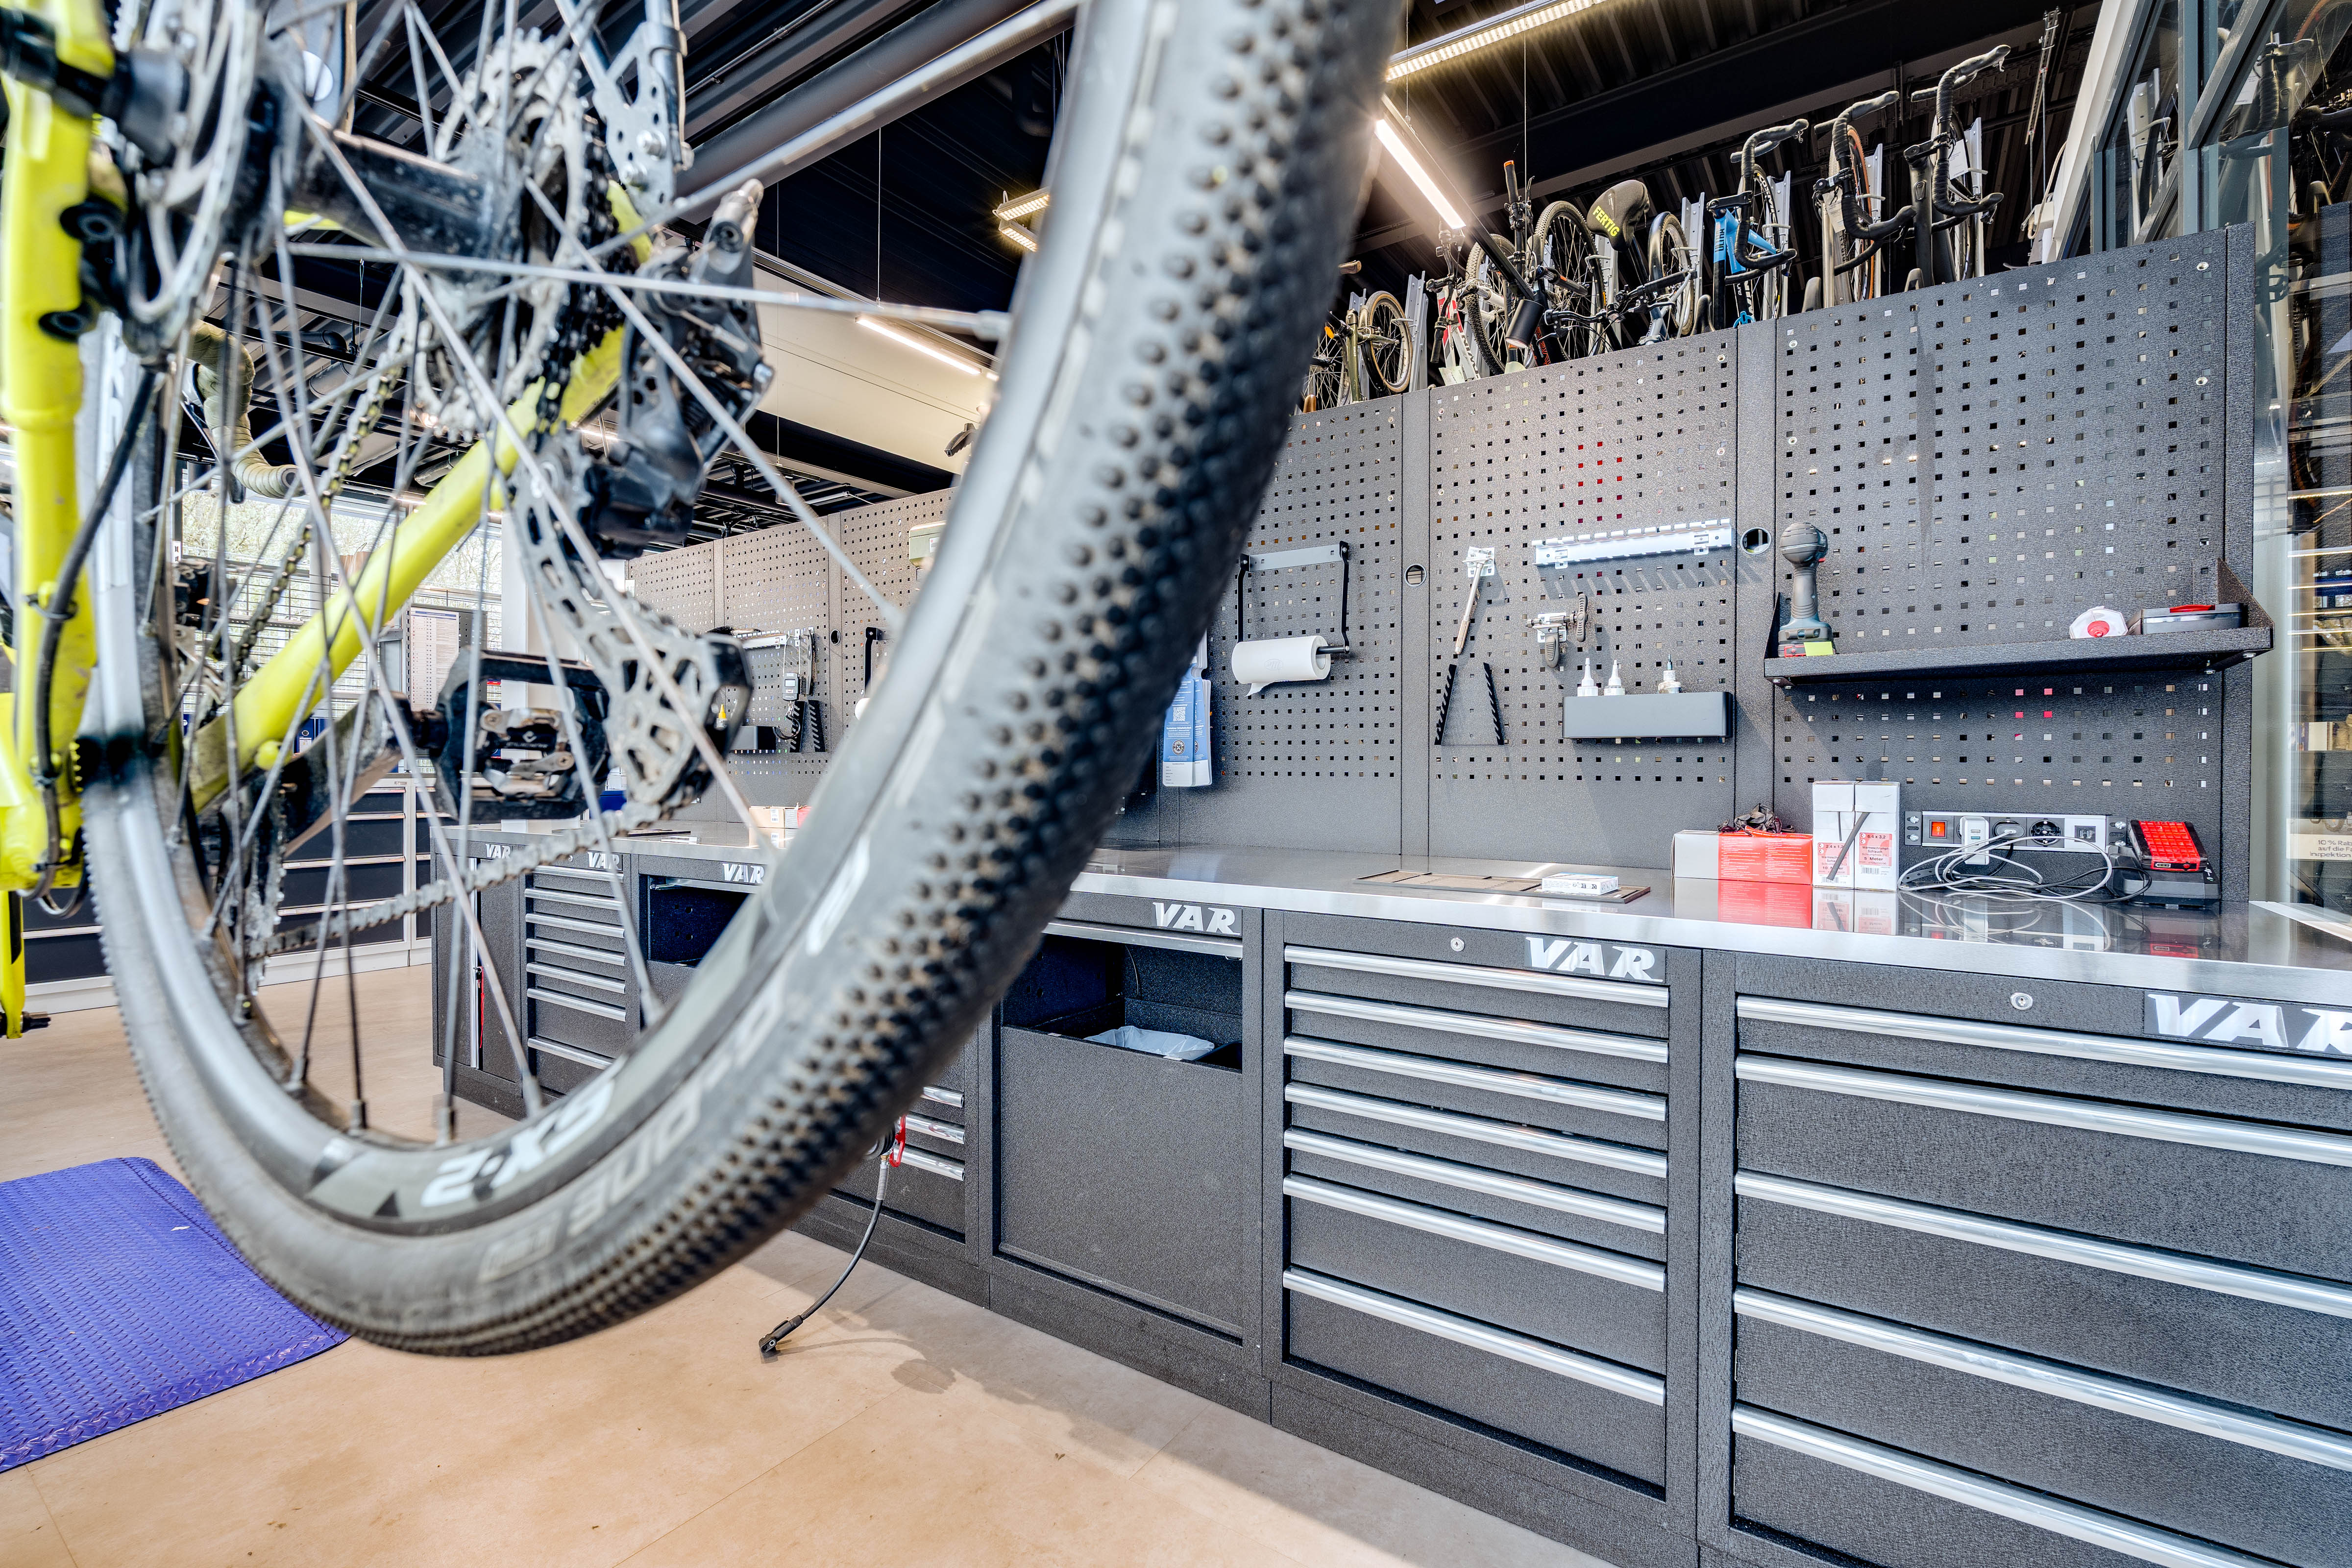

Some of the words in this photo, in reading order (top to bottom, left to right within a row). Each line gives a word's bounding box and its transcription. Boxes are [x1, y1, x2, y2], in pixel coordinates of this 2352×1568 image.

[1592, 205, 1620, 237] FERTIG
[486, 844, 511, 859] VAR
[588, 852, 620, 871] VAR
[722, 863, 765, 884] VAR
[1152, 902, 1241, 935] VAR
[1525, 936, 1663, 982] VAR
